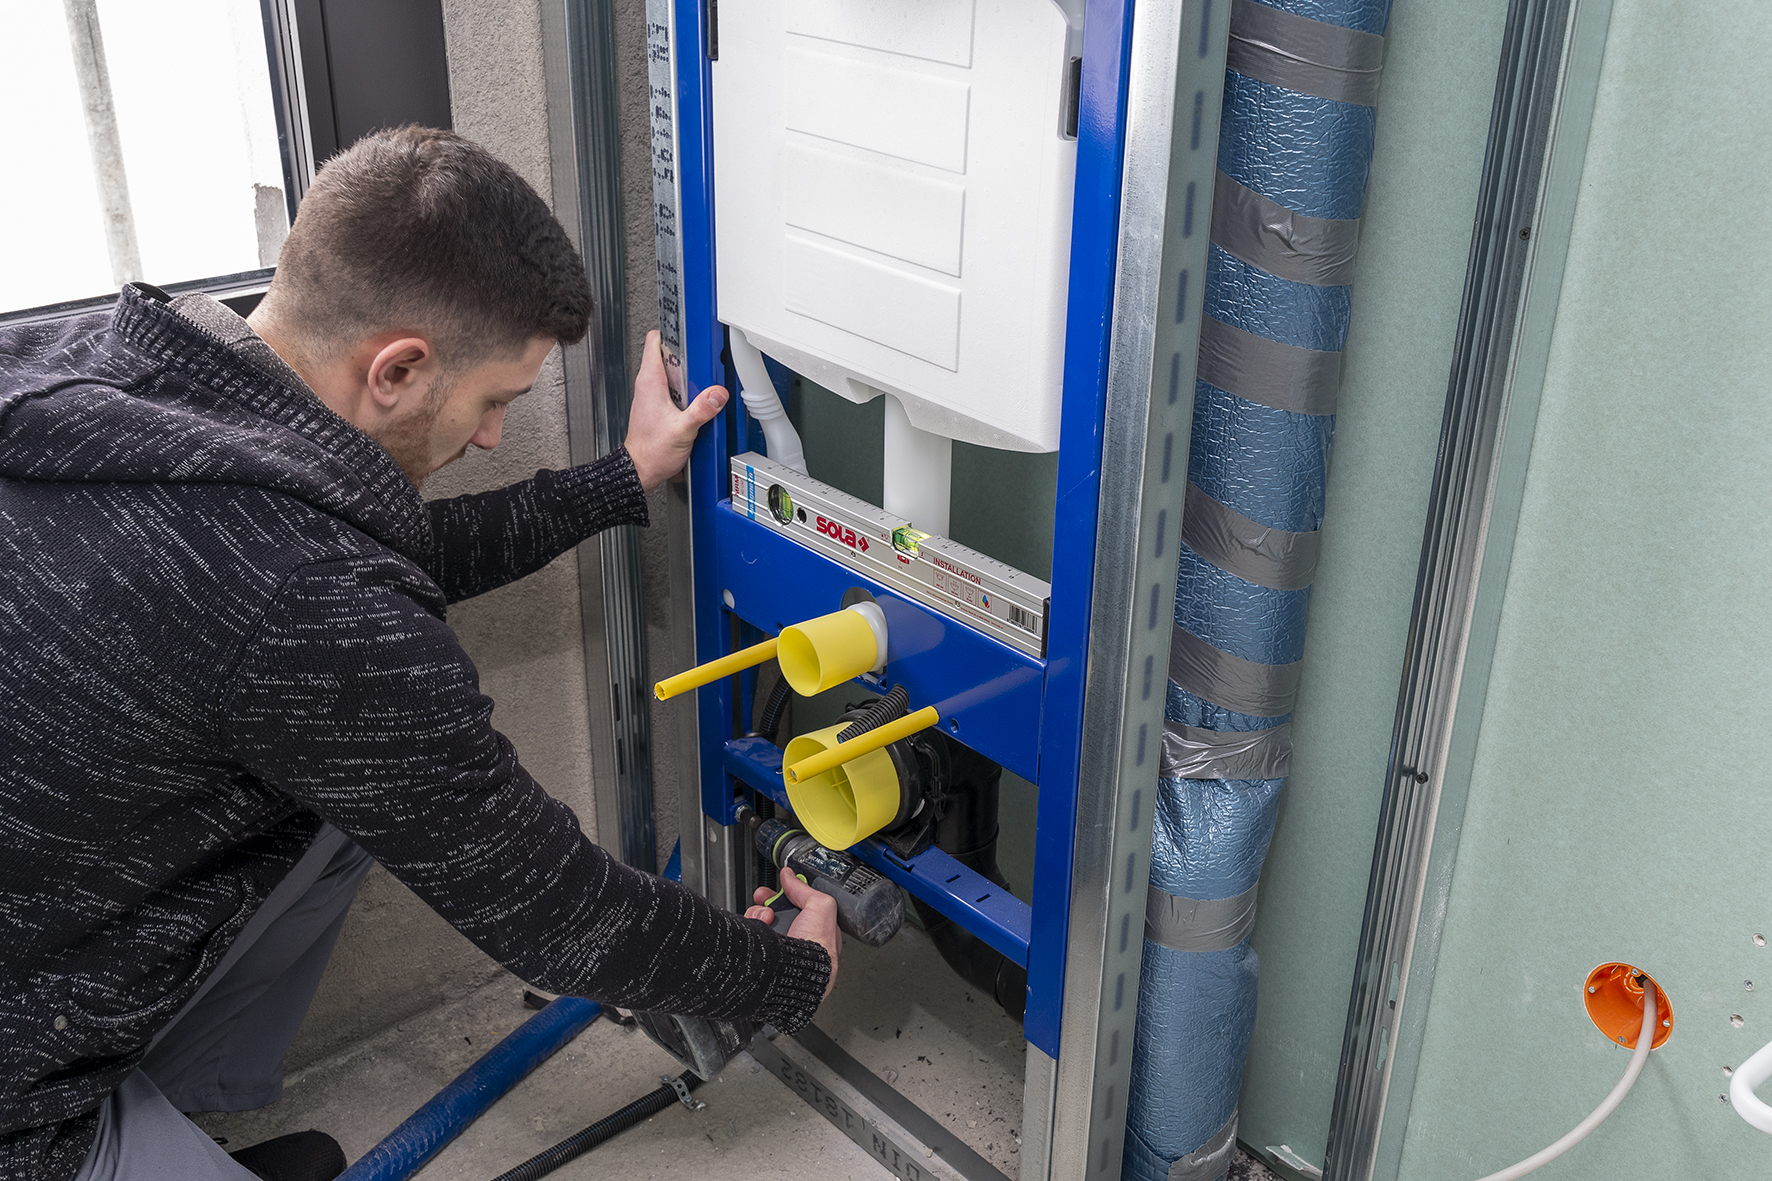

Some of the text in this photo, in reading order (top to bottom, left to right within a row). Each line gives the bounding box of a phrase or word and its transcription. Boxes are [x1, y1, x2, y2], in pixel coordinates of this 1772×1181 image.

[647, 22, 669, 63] EN
[650, 85, 674, 185] 14195
[933, 556, 982, 586] INSTALLATION
[780, 1057, 921, 1181] DIN 18182
